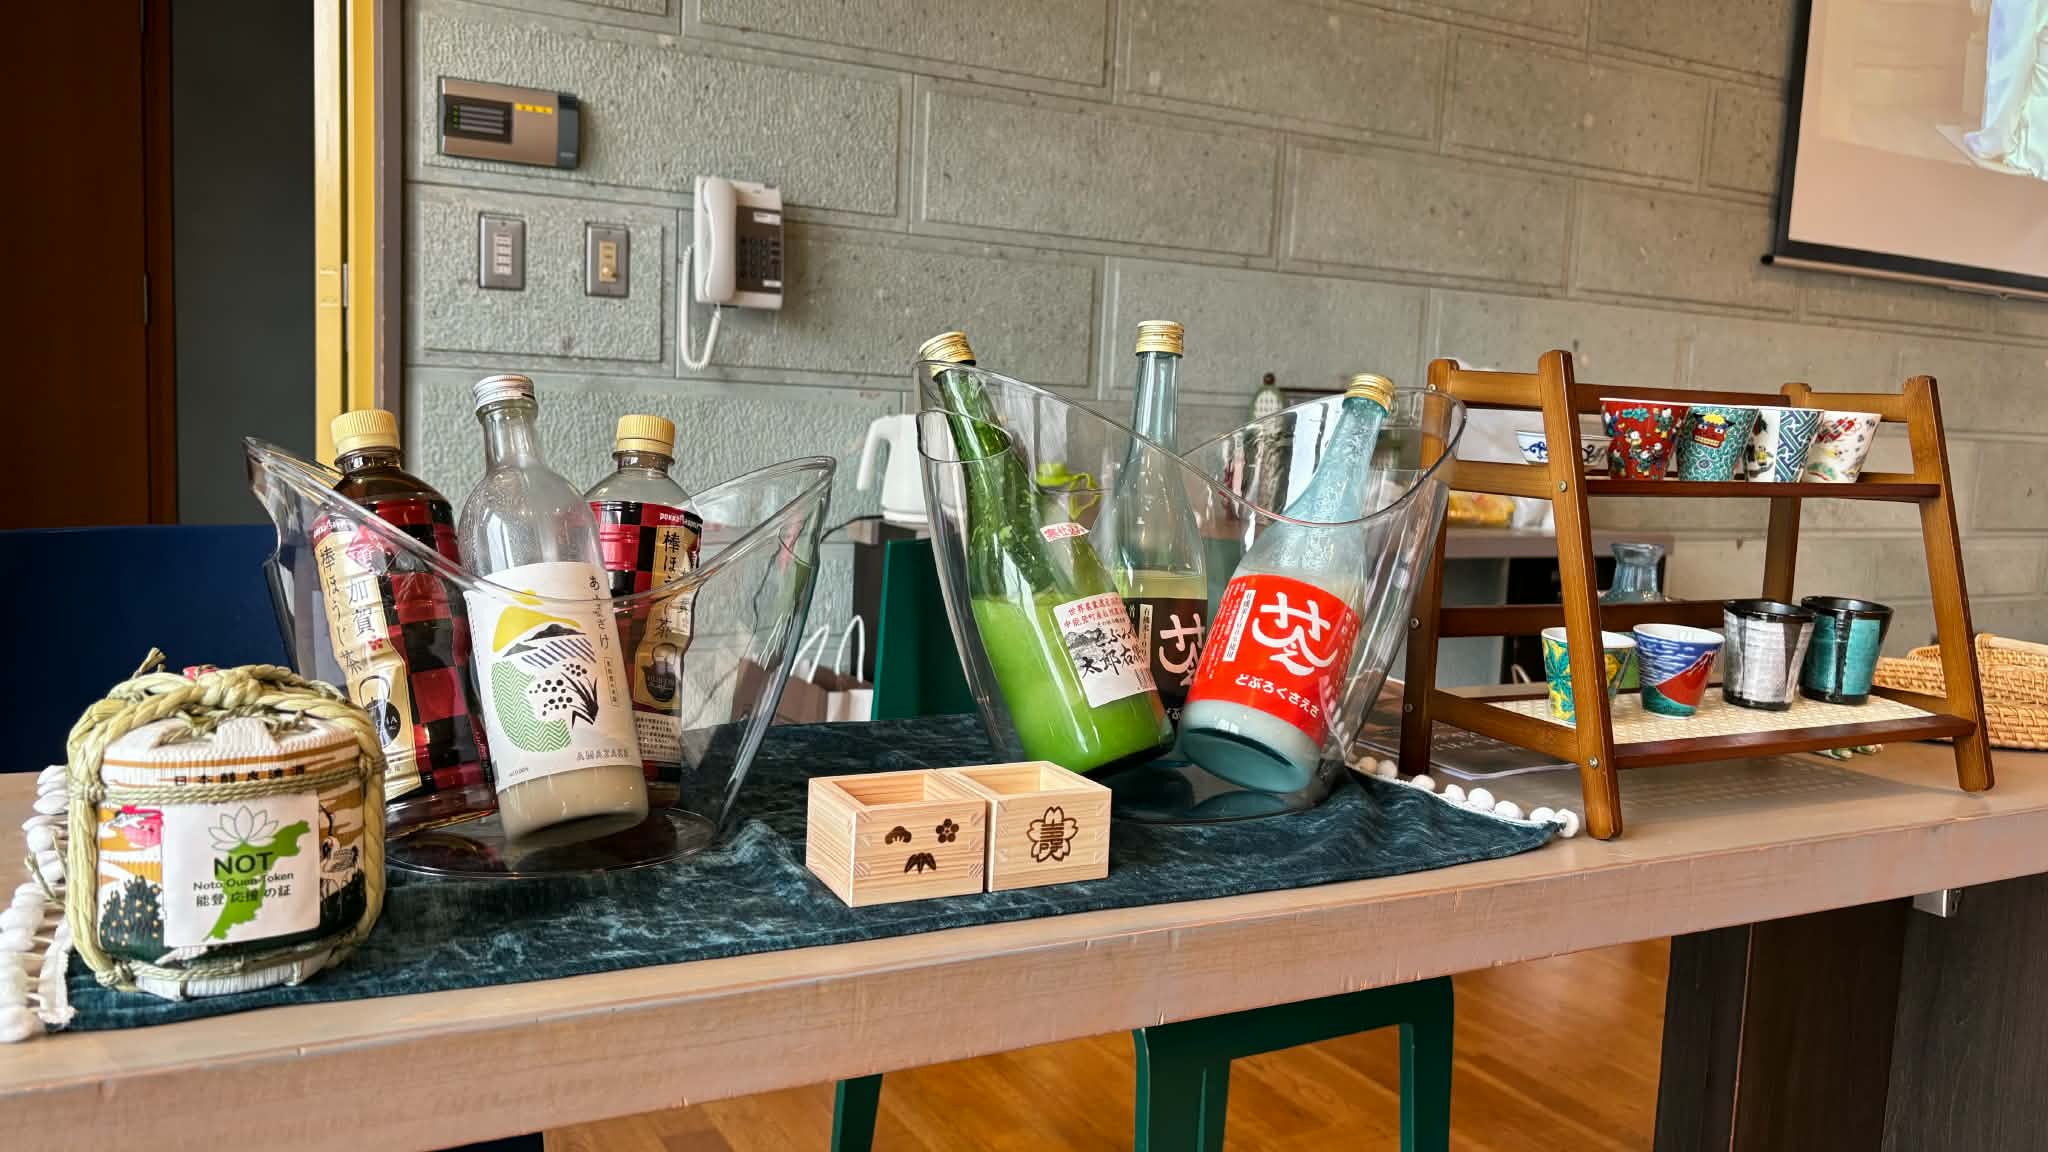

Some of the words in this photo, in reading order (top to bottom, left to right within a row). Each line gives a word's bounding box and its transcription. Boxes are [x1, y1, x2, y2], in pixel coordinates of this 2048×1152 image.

[347, 578, 376, 637] 加賀
[1235, 673, 1320, 719] どぶろくさえさ
[193, 881, 224, 892] Noto
[262, 871, 294, 883] Token
[213, 851, 274, 877] NOT
